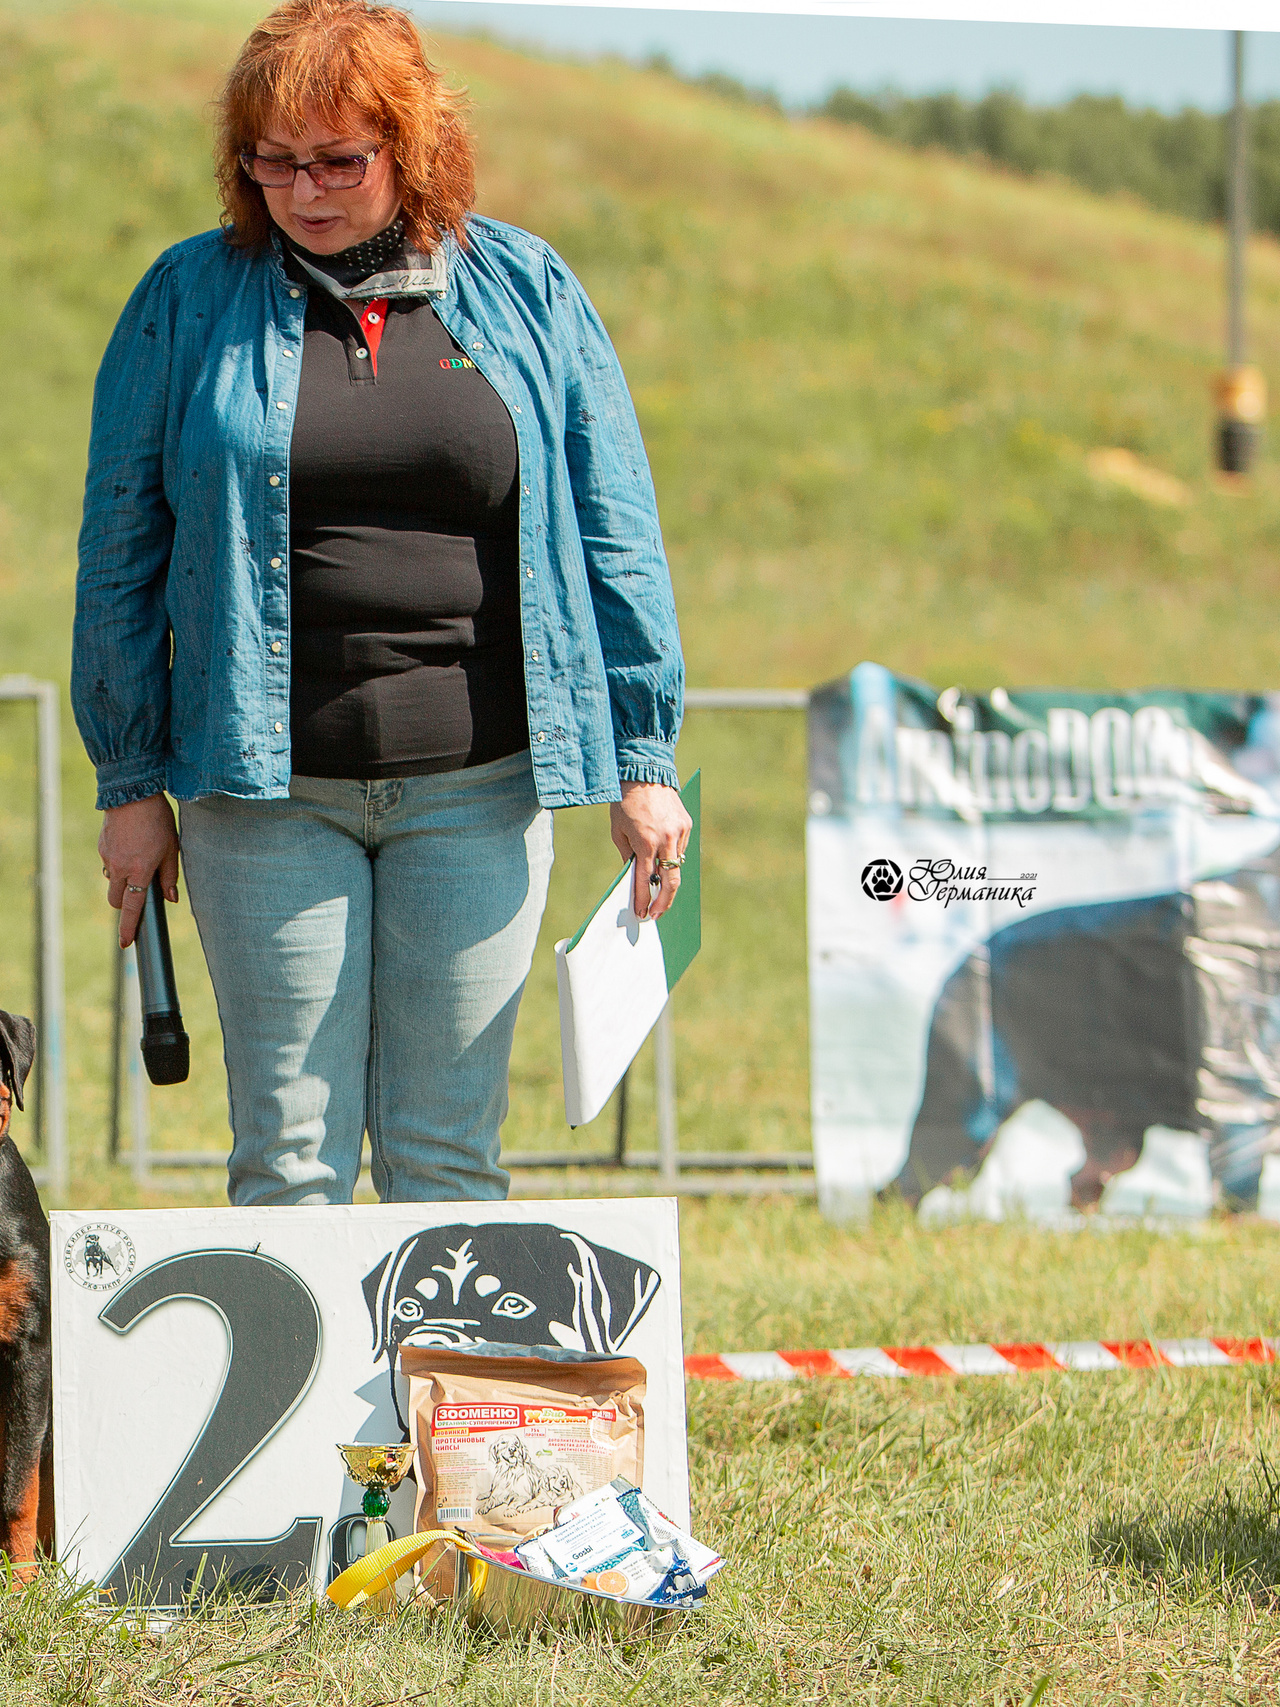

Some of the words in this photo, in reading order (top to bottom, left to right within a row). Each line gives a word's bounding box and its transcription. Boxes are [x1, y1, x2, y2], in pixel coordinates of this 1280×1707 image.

[96, 1223, 121, 1235] КЛУБ
[438, 1408, 517, 1420] ЗООМЕНЮ
[99, 1249, 322, 1606] 2
[435, 1437, 486, 1445] ПРОТЕИНОВЫЕ
[572, 1545, 594, 1560] Gosbi
